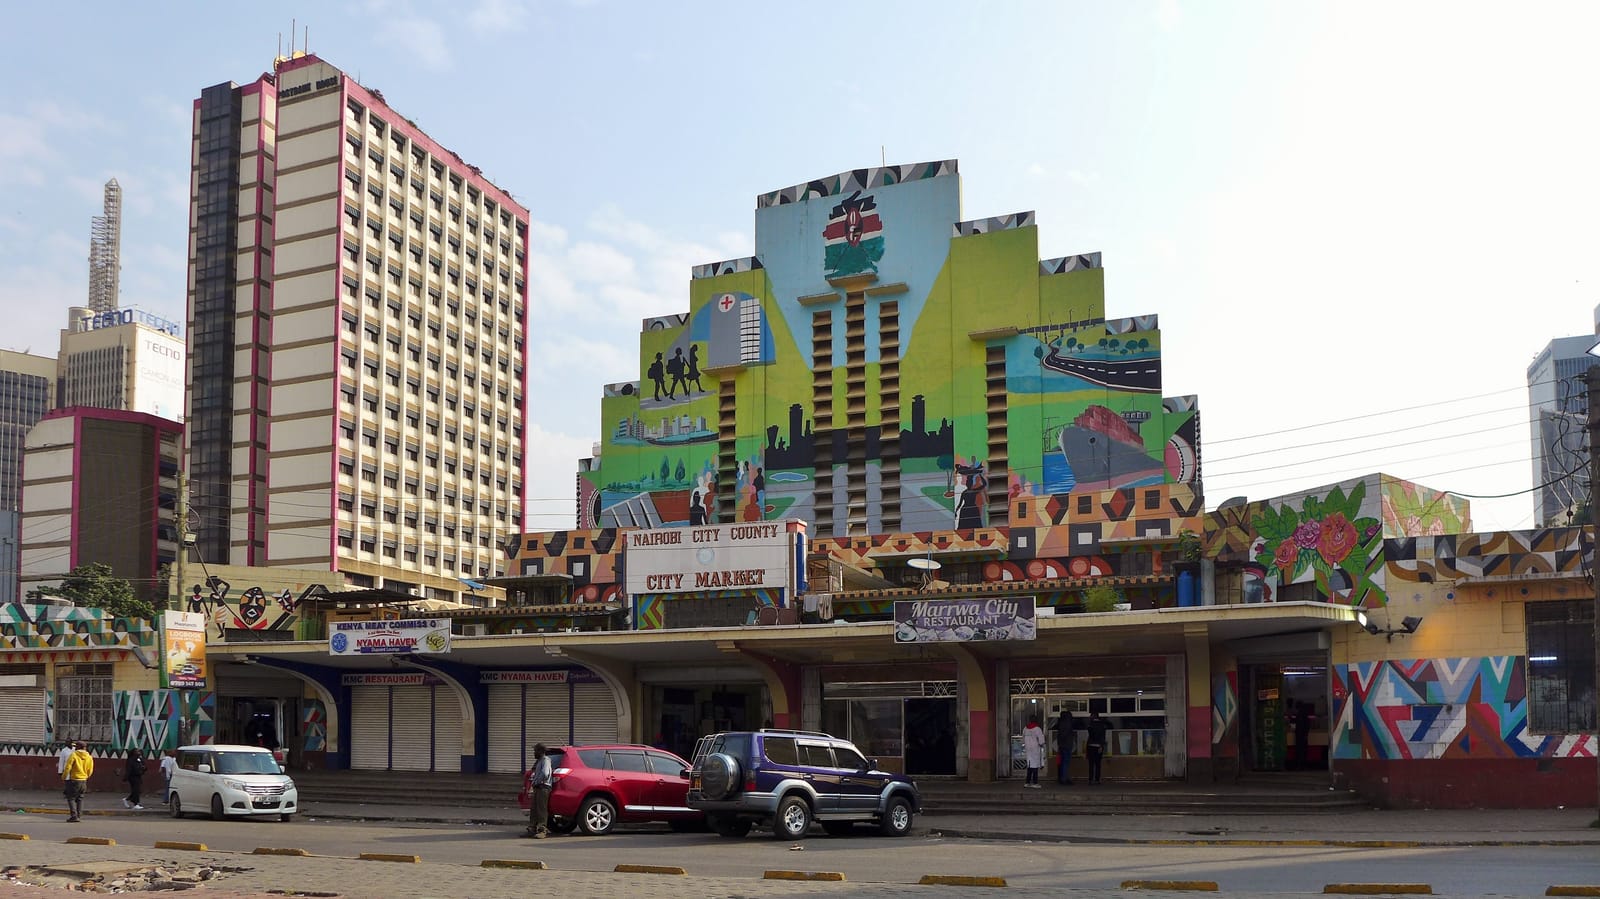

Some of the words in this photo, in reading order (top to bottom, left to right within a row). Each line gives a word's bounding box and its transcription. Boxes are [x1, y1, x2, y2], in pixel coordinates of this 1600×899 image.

[82, 309, 133, 332] TECNO
[145, 340, 181, 361] TECNO
[633, 531, 682, 546] NAIROBI
[692, 529, 721, 543] CITY
[730, 525, 778, 540] COUNTY
[646, 573, 684, 590] CITY
[694, 569, 766, 588] MARKET
[911, 602, 980, 618] Marrwa
[985, 599, 1018, 620] City
[365, 621, 387, 629] MEAT
[924, 615, 1000, 627] RESTAURANT
[356, 639, 386, 647] NYAMA
[343, 675, 363, 684] KMC
[365, 674, 422, 684] RESTAURANT
[480, 672, 499, 681] KMC
[501, 672, 532, 681] NYAMA
[534, 672, 565, 681] HAVEN
